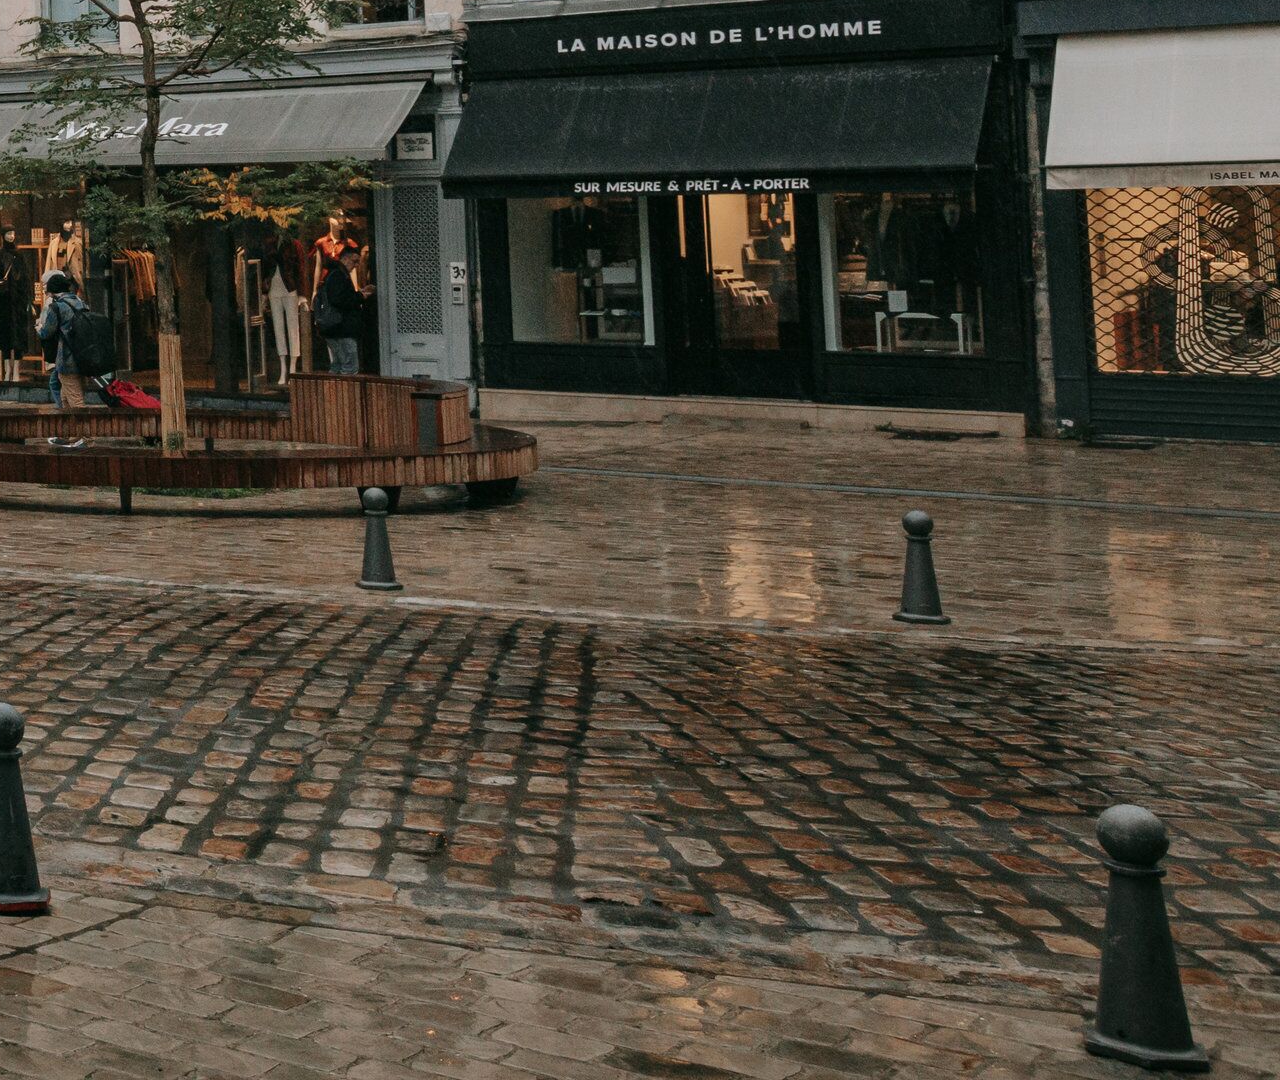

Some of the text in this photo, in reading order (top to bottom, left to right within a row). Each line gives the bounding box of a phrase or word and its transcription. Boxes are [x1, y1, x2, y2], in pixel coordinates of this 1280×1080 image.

[557, 20, 882, 53] LA MAISON DE L'HOMME
[1210, 171, 1255, 180] ISABEL
[574, 181, 600, 193] SUR
[606, 181, 661, 193] MESURE
[667, 180, 679, 191] &
